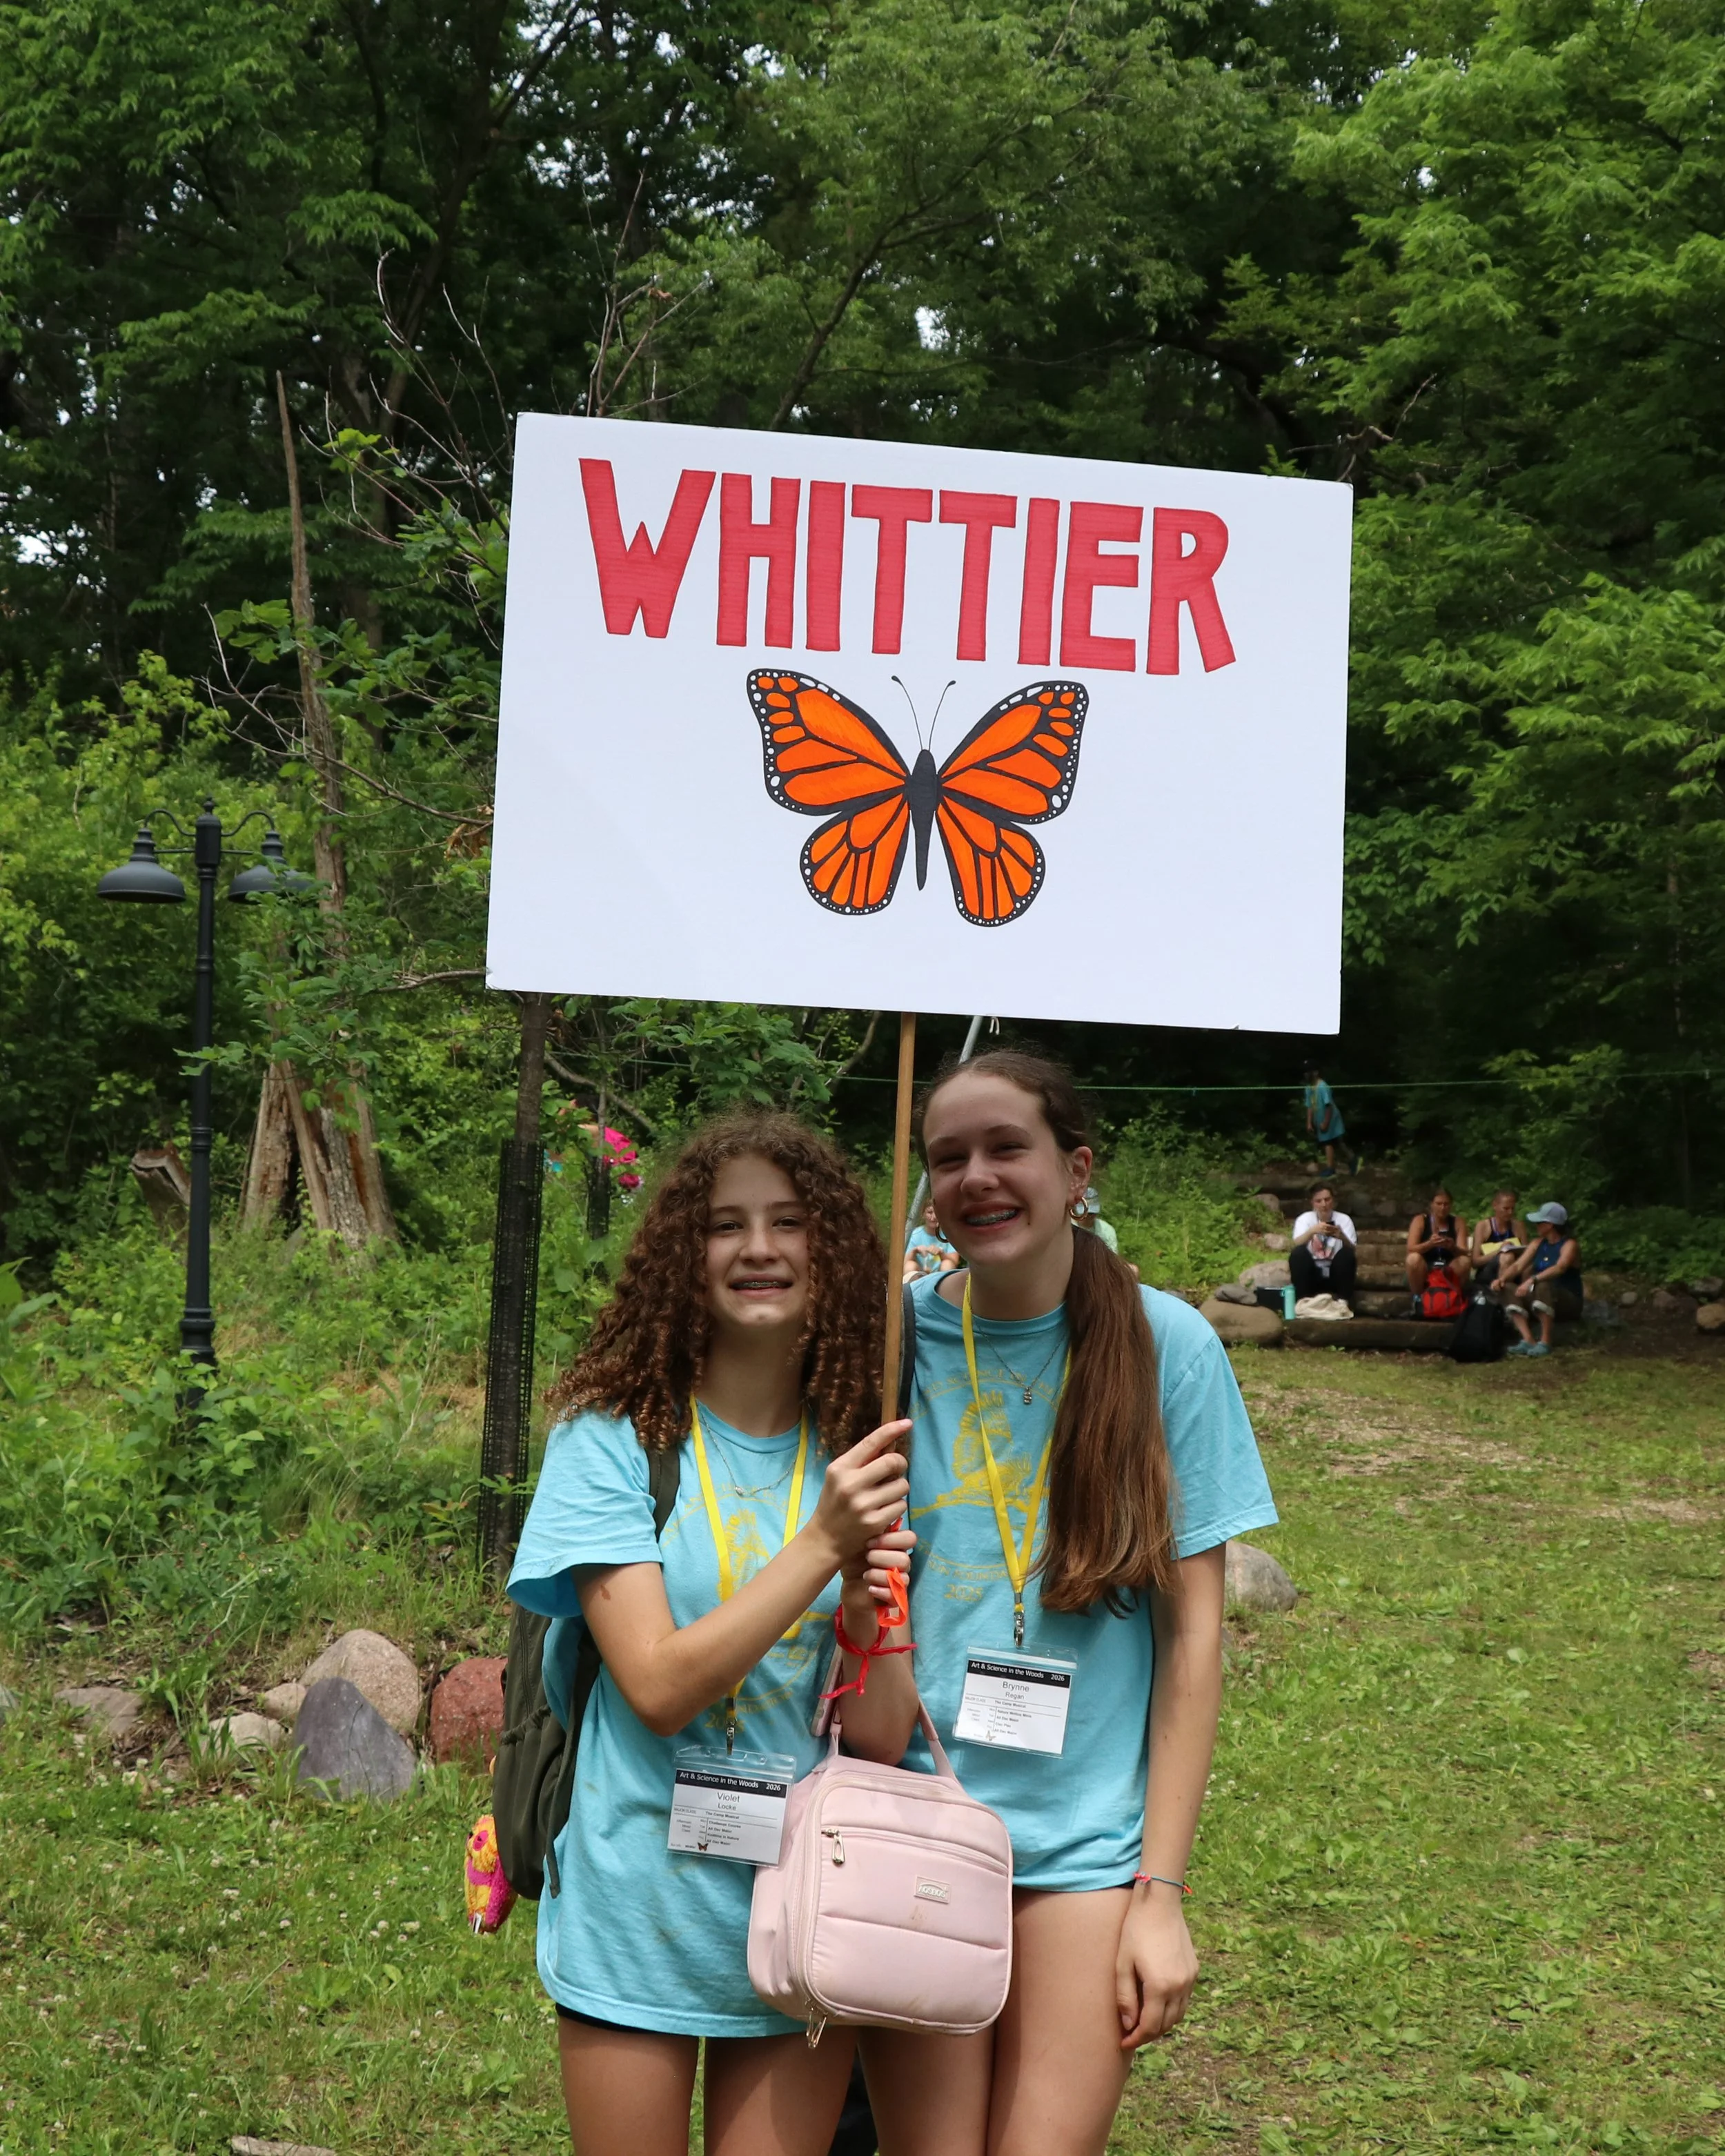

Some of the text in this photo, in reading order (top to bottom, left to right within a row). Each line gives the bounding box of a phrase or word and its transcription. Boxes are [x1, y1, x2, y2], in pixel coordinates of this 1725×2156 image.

[578, 458, 1236, 675] WHITTIER
[987, 1665, 1007, 1673] Science
[1015, 1668, 1025, 1676] the
[1025, 1670, 1044, 1679] Woods
[1050, 1673, 1065, 1681] 2026
[1002, 1681, 1029, 1692] Brynne
[1005, 1691, 1025, 1701] Regan
[696, 1774, 719, 1783] Science
[727, 1777, 738, 1786] the
[738, 1779, 758, 1788] Woods
[766, 1783, 781, 1792] 2026
[717, 1792, 740, 1803] Violet
[718, 1803, 737, 1811] Locke
[918, 1885, 946, 1899] AOSBOS
